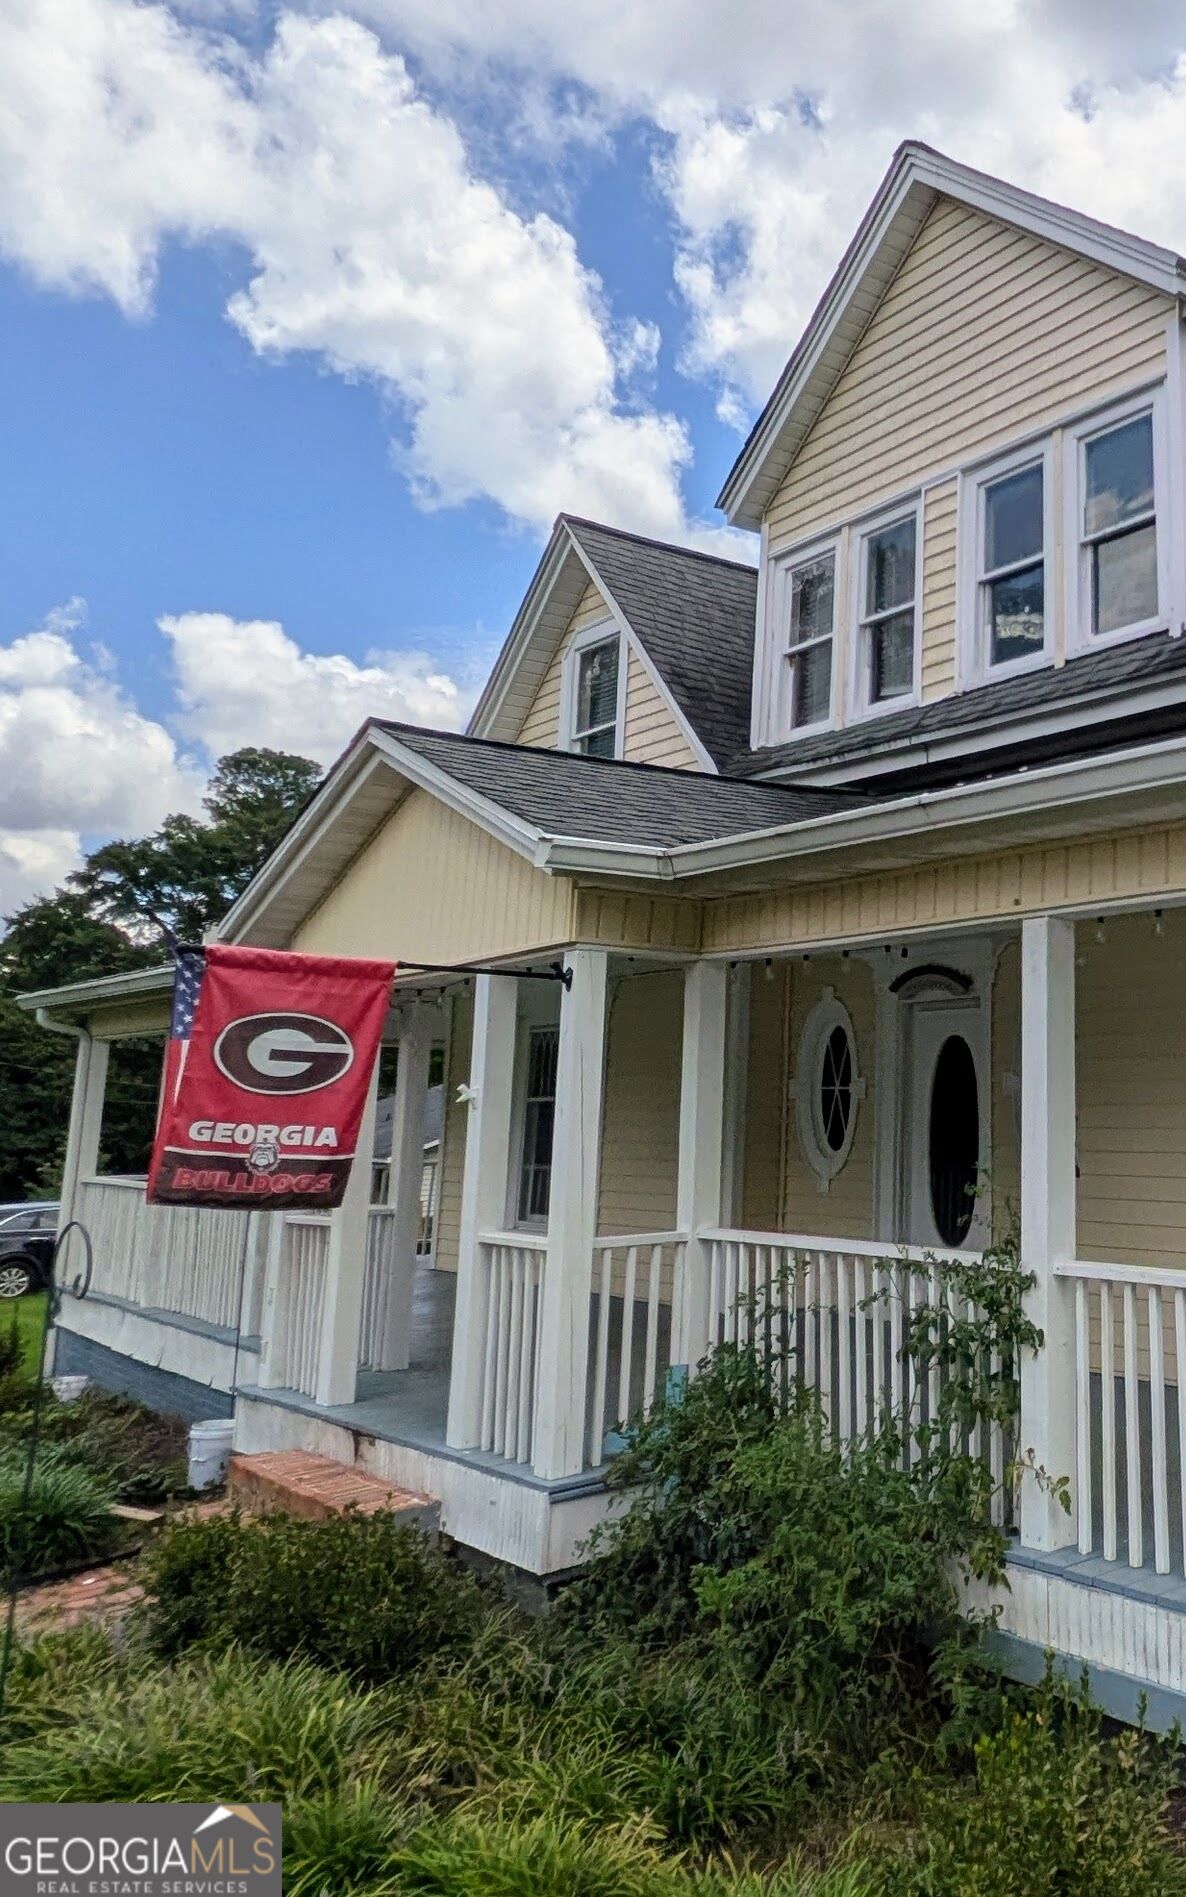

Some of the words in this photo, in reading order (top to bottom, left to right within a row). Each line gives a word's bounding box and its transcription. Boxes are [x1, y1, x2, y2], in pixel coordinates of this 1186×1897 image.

[214, 1013, 354, 1094] G
[189, 1121, 337, 1147] GEORGIA
[173, 1168, 333, 1193] BULLDOGS
